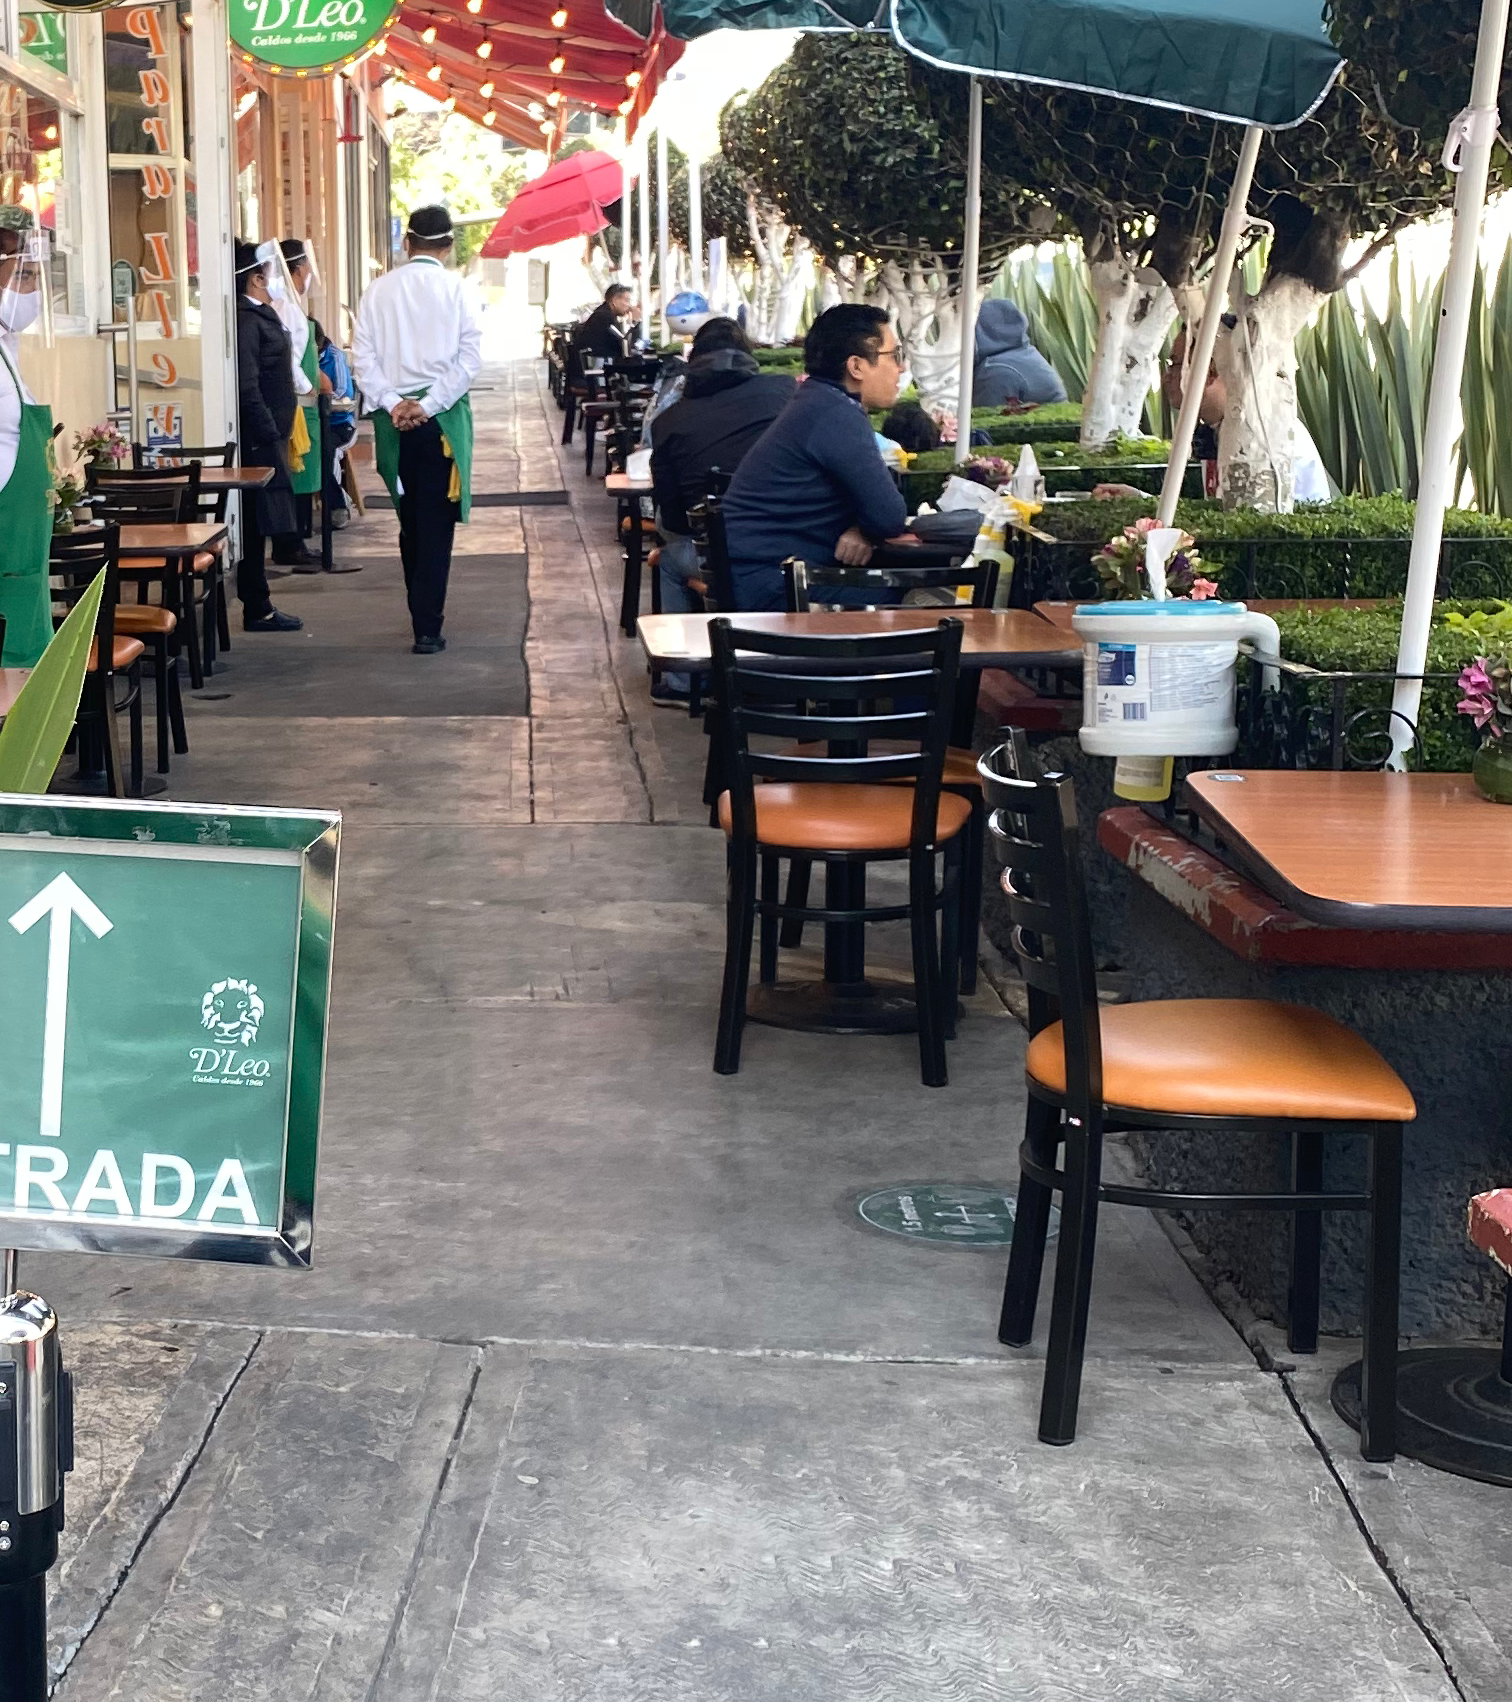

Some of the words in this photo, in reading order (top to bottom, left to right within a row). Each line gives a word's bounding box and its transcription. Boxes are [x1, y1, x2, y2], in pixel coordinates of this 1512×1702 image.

[251, 34, 292, 47] Caldos
[294, 31, 327, 44] desde
[330, 30, 358, 42] 1966
